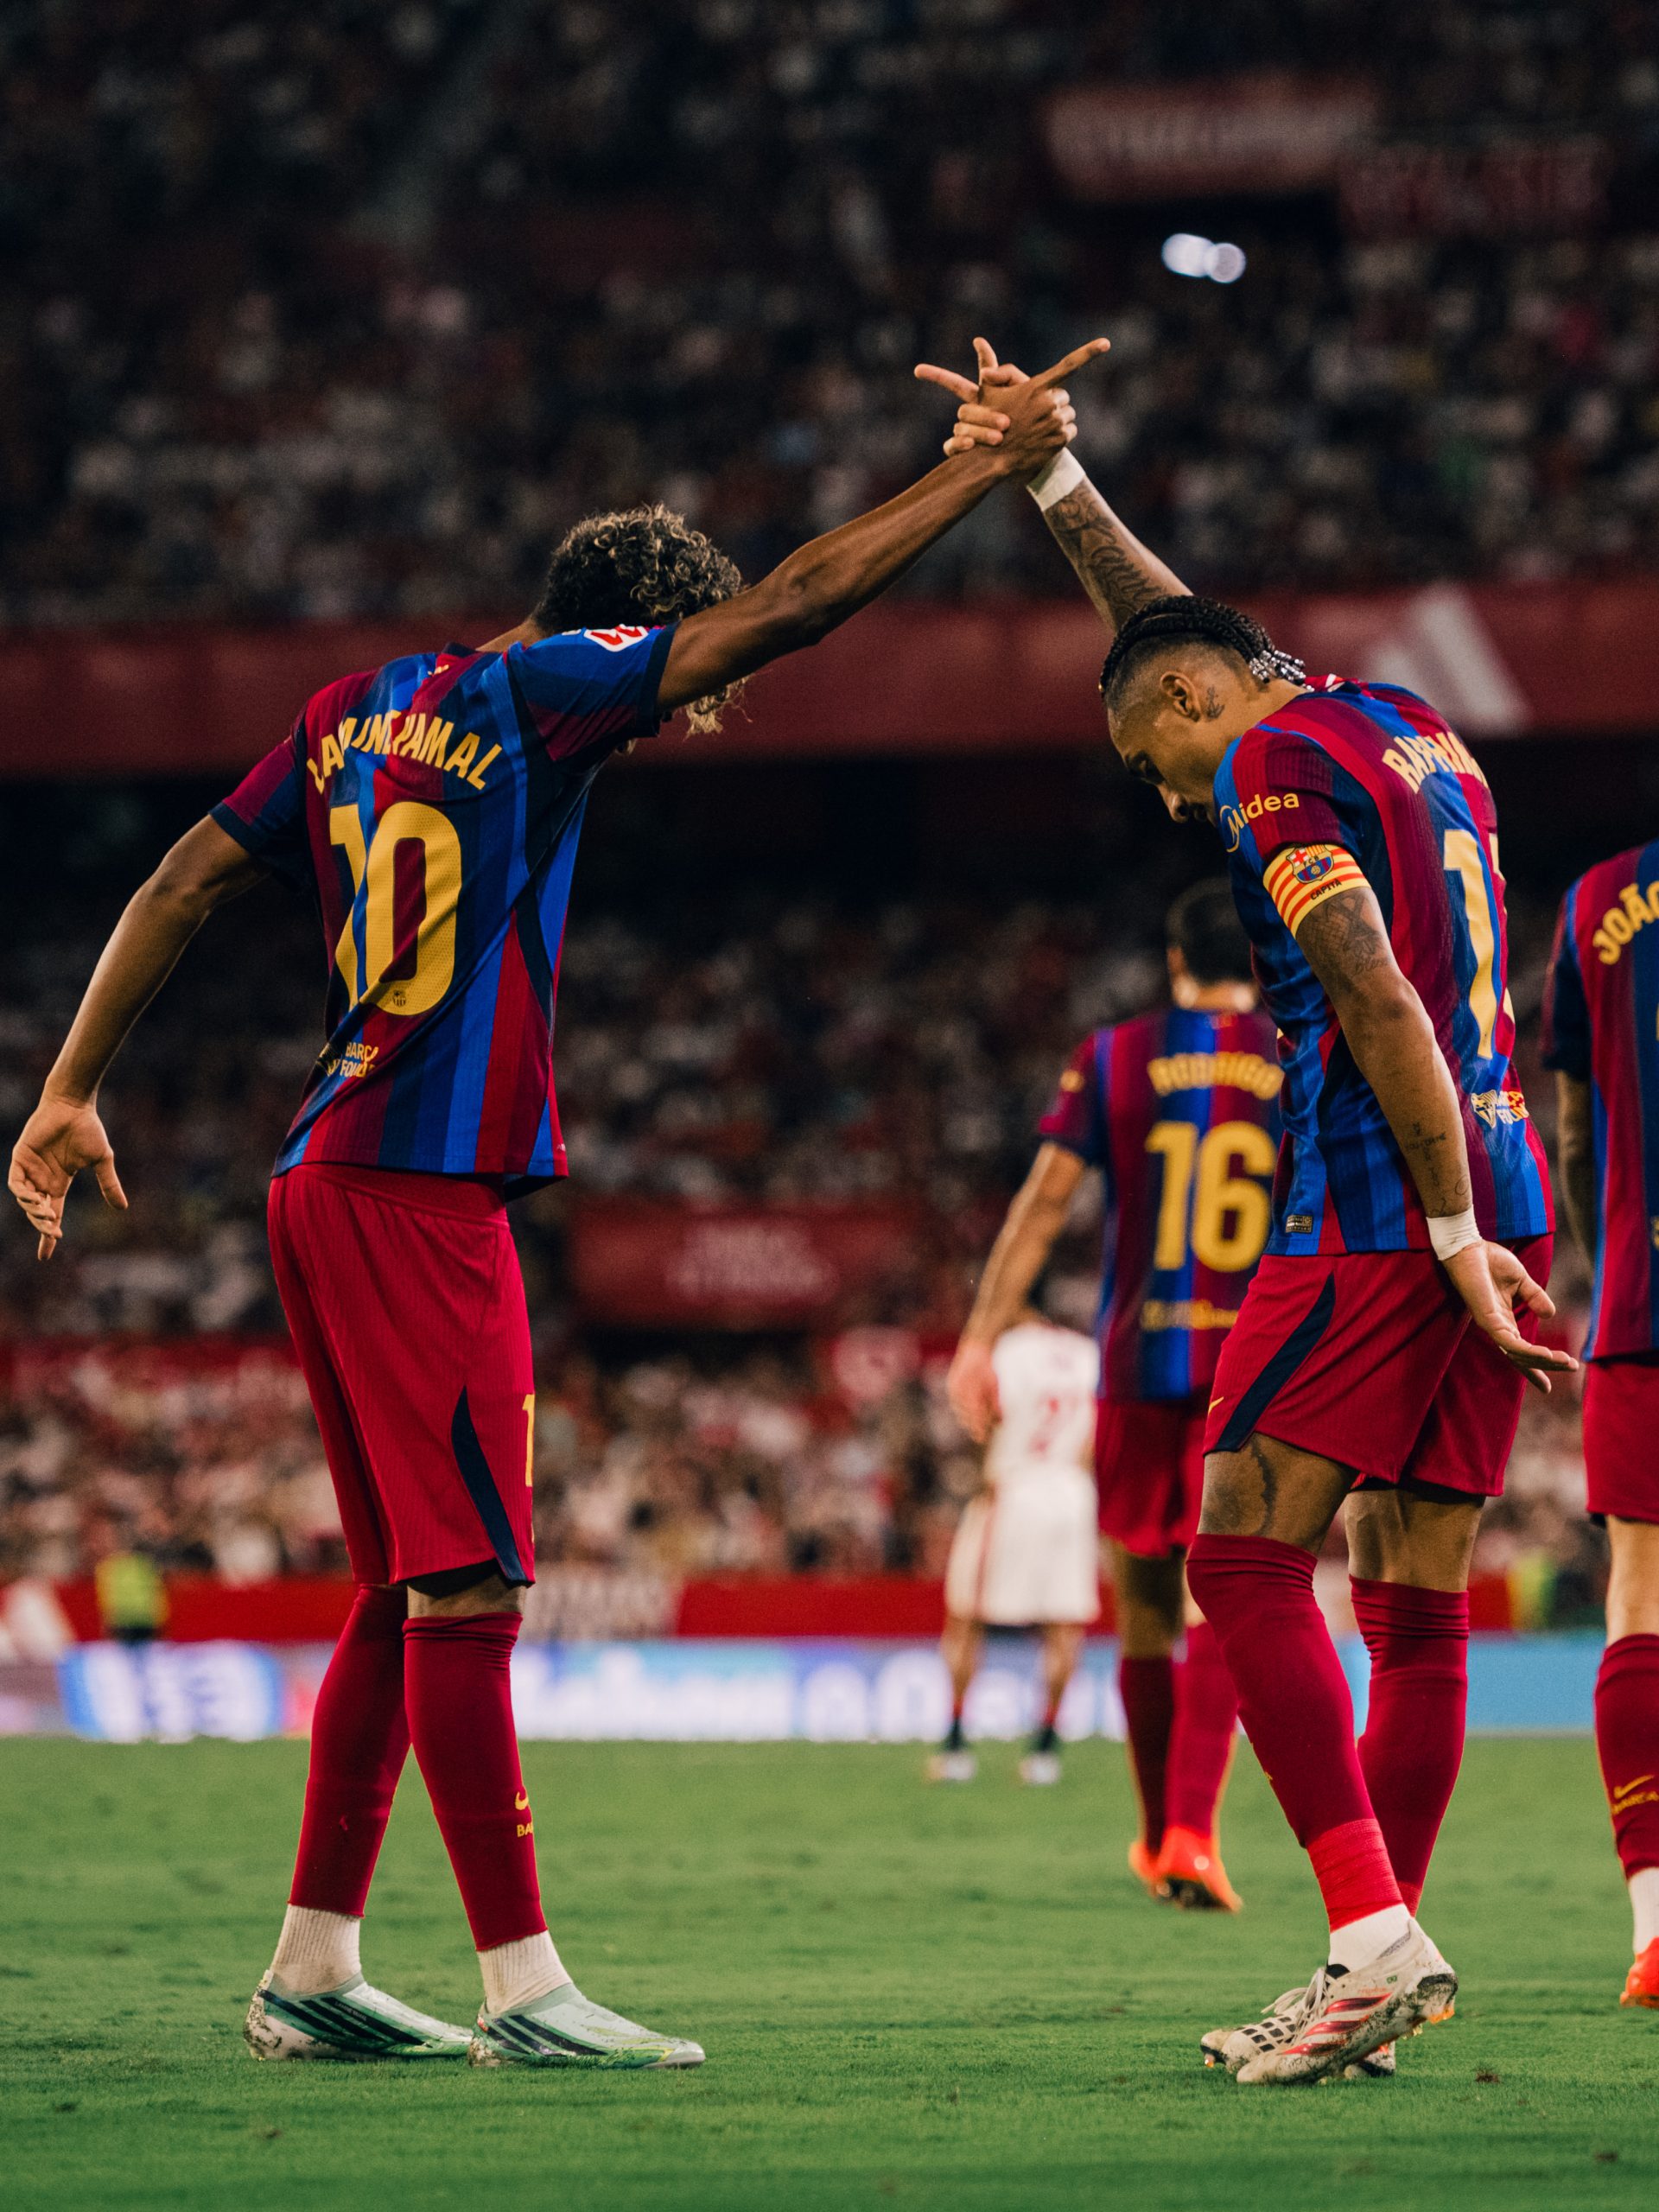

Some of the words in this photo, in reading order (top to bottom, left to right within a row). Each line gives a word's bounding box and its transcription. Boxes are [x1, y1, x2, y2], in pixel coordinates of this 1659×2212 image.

[1219, 792, 1300, 853] Midea
[329, 800, 462, 1016] 10
[1145, 1121, 1277, 1272] 16
